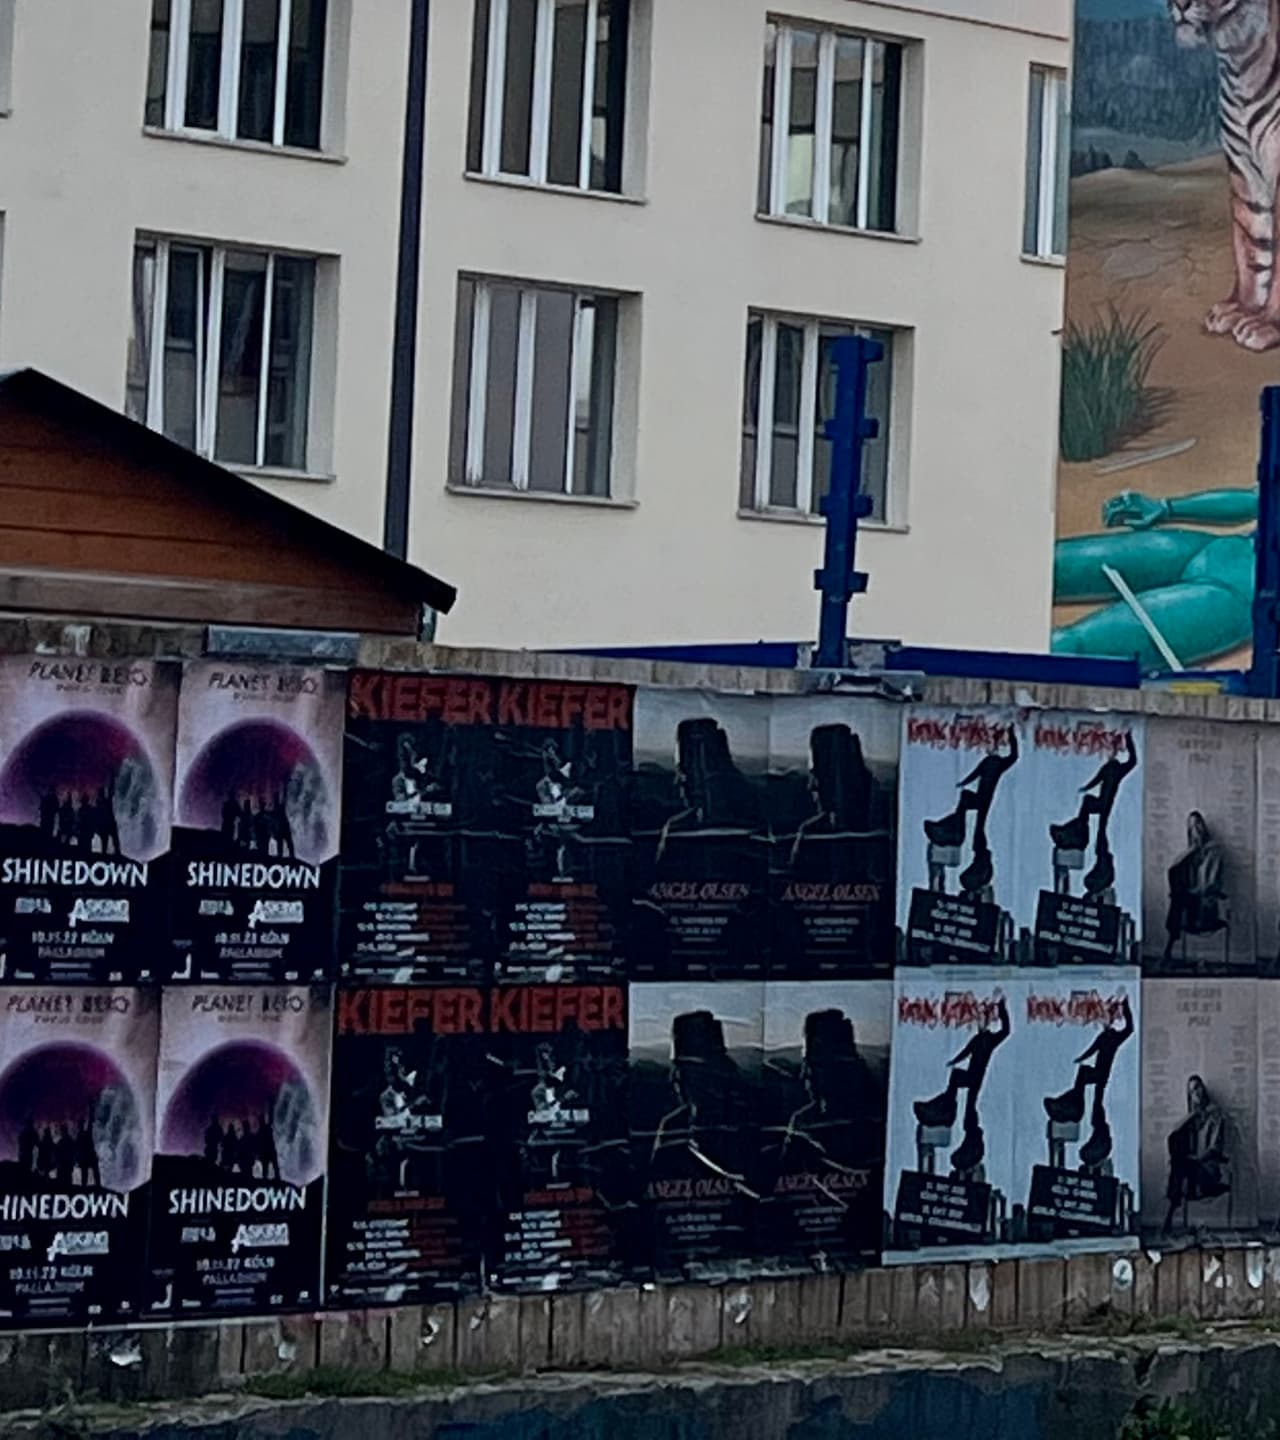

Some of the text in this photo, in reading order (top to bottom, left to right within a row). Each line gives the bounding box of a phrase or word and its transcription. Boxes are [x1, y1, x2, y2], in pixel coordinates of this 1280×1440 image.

[27, 661, 95, 682] PLANET
[208, 671, 270, 691] PLANET
[350, 673, 492, 726] KIEFER
[498, 682, 629, 730] KIEFER
[1, 859, 148, 886] SHINEDOWN
[187, 862, 321, 889] SHINEDOWN
[7, 994, 73, 1013] PLANET
[192, 994, 254, 1013] PLANET
[337, 987, 483, 1035] KIEFER
[490, 986, 624, 1033] KIEFER
[0, 1193, 129, 1221] HINEDOWN
[168, 1186, 307, 1214] SHINEDOWN
